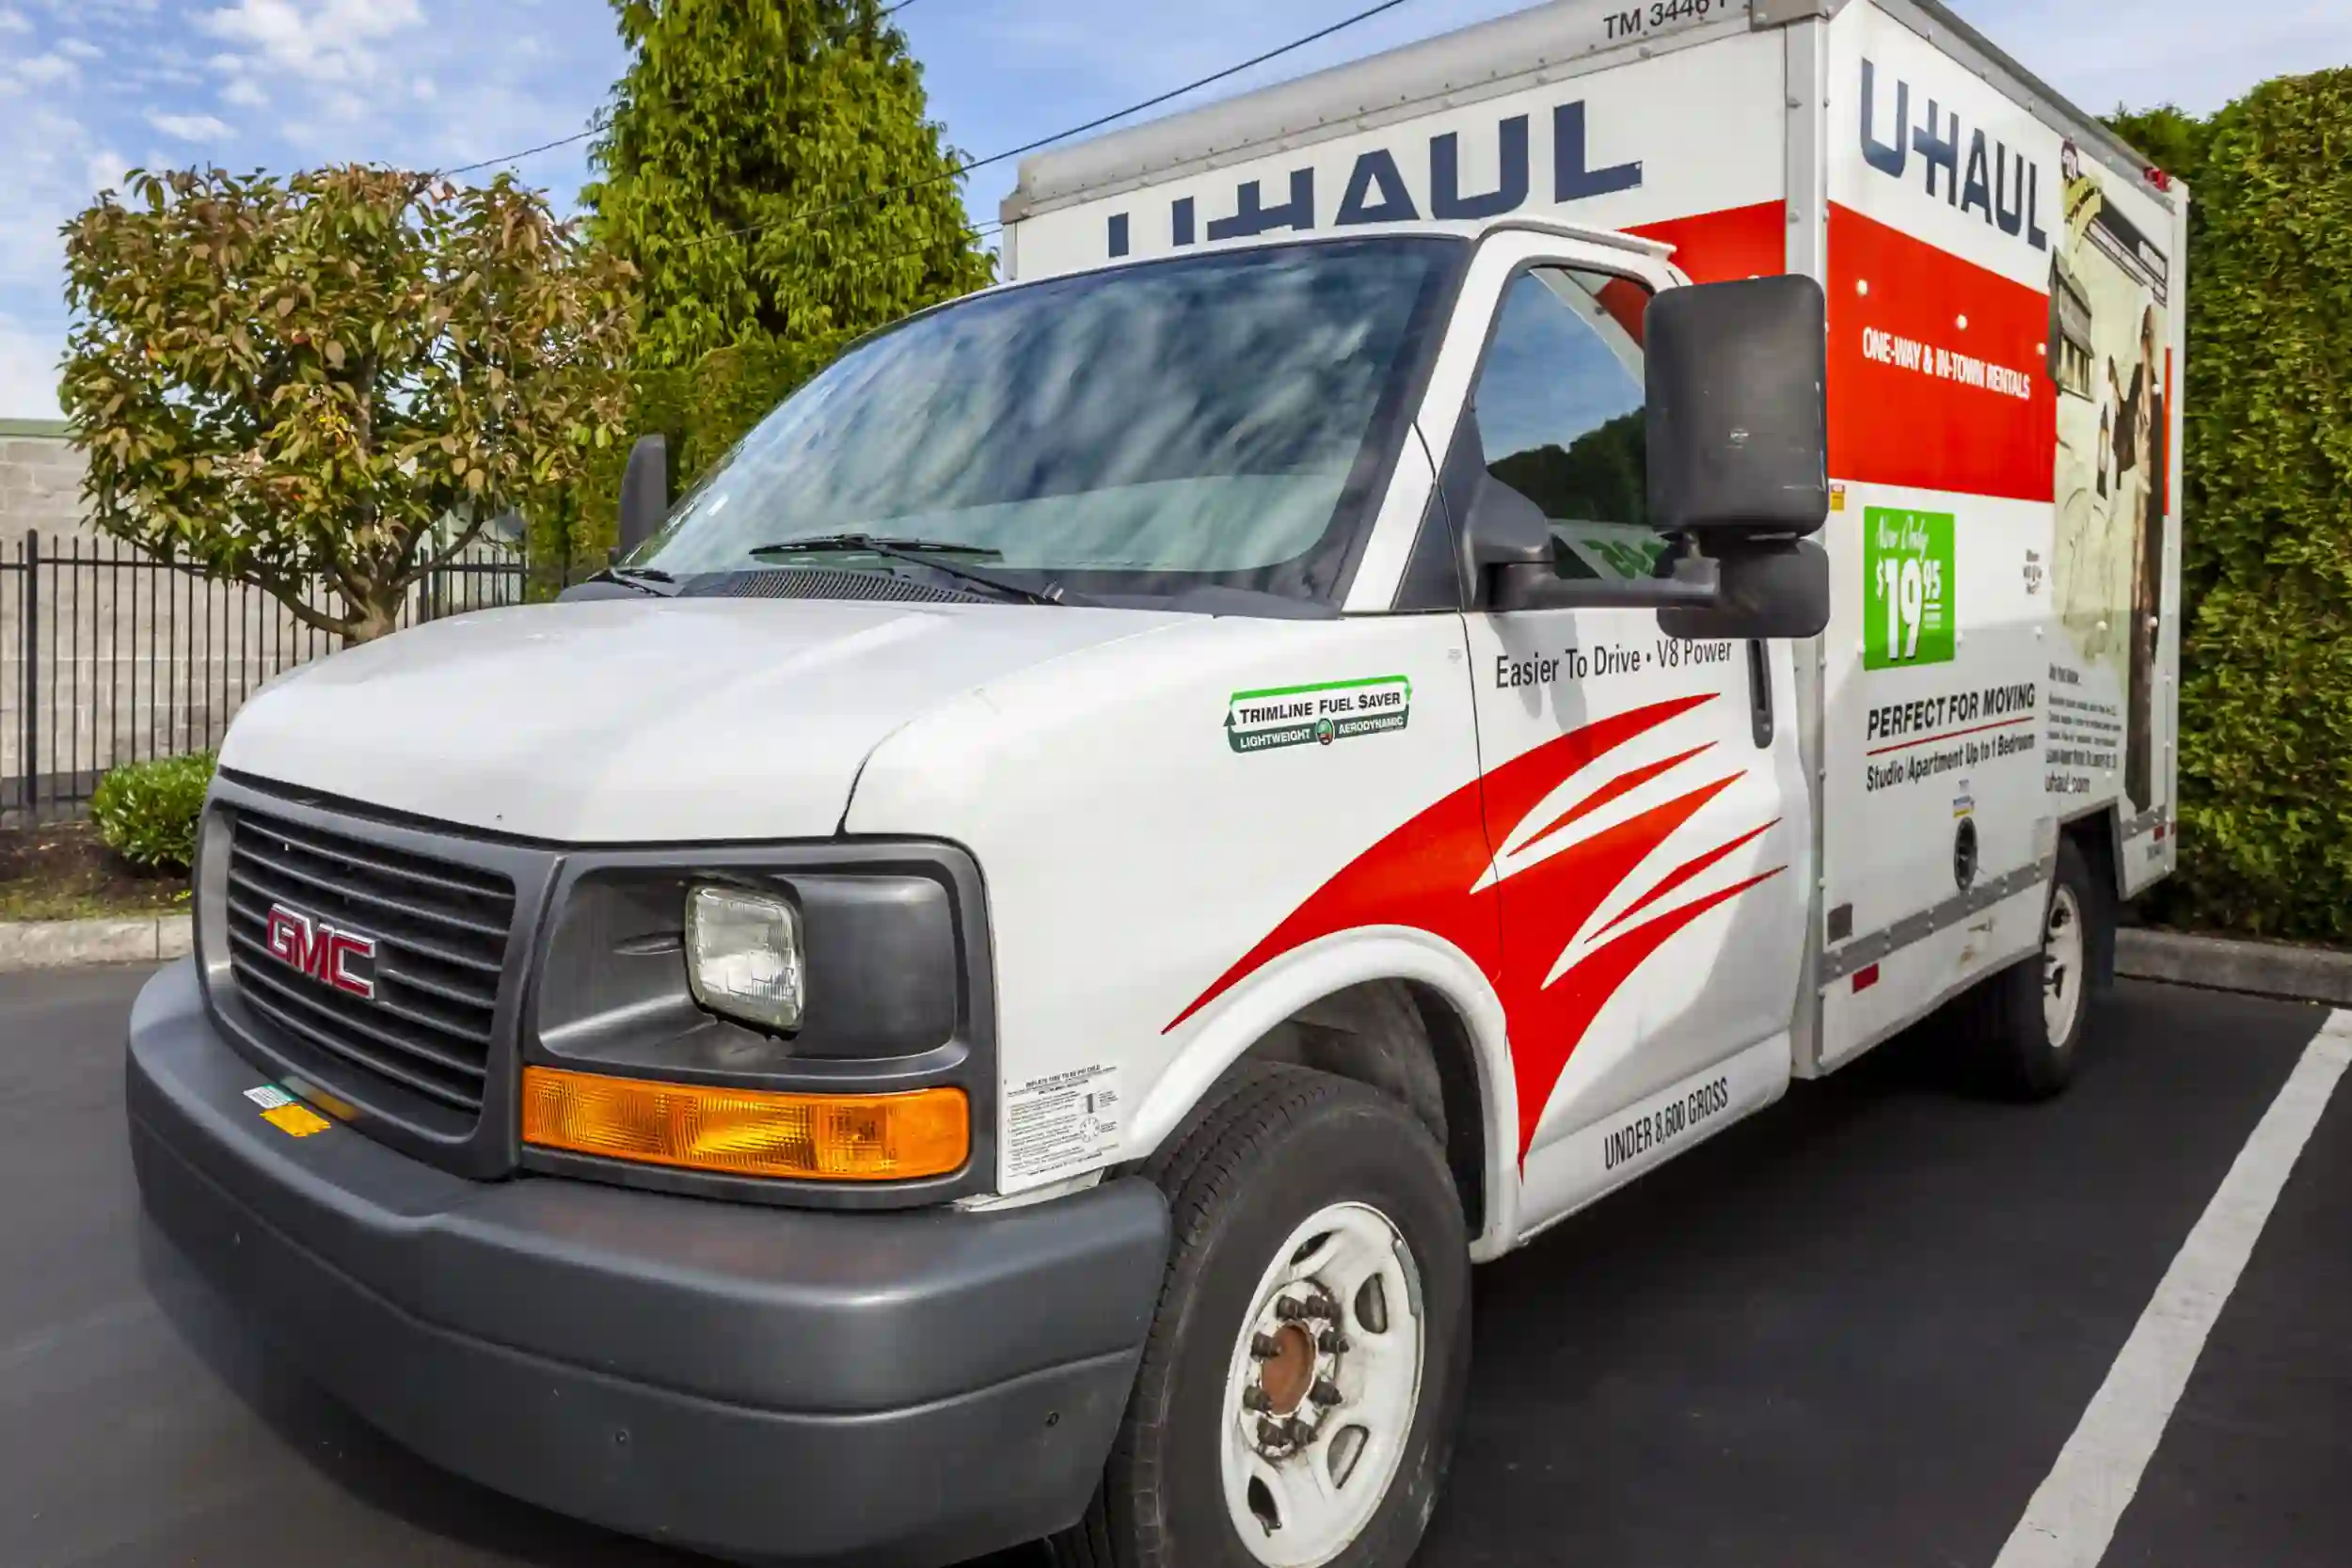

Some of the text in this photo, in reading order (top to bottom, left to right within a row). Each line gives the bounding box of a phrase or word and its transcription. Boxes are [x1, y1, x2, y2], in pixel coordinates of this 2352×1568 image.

[1603, 8, 1641, 40] TM
[1863, 326, 2030, 400] ONE-WAY & IN-TOWN RENTALS
[1497, 638, 1732, 689] Easier To Drive V8 Power
[1239, 692, 1401, 724] TRIMLINE FUEL SAVER
[1240, 717, 1404, 749] LIGHTWEIGHT AERODYNAMIC
[1867, 697, 1945, 740] PERFECT
[1948, 691, 1979, 723] FOR
[1982, 683, 2035, 717] MOVING
[1965, 741, 1979, 768] Up
[1980, 740, 1991, 761] to
[1997, 734, 2035, 757] Bedroom
[266, 903, 375, 1000] GMC
[1604, 1076, 1728, 1170] UNDER 8,600 GROSS
